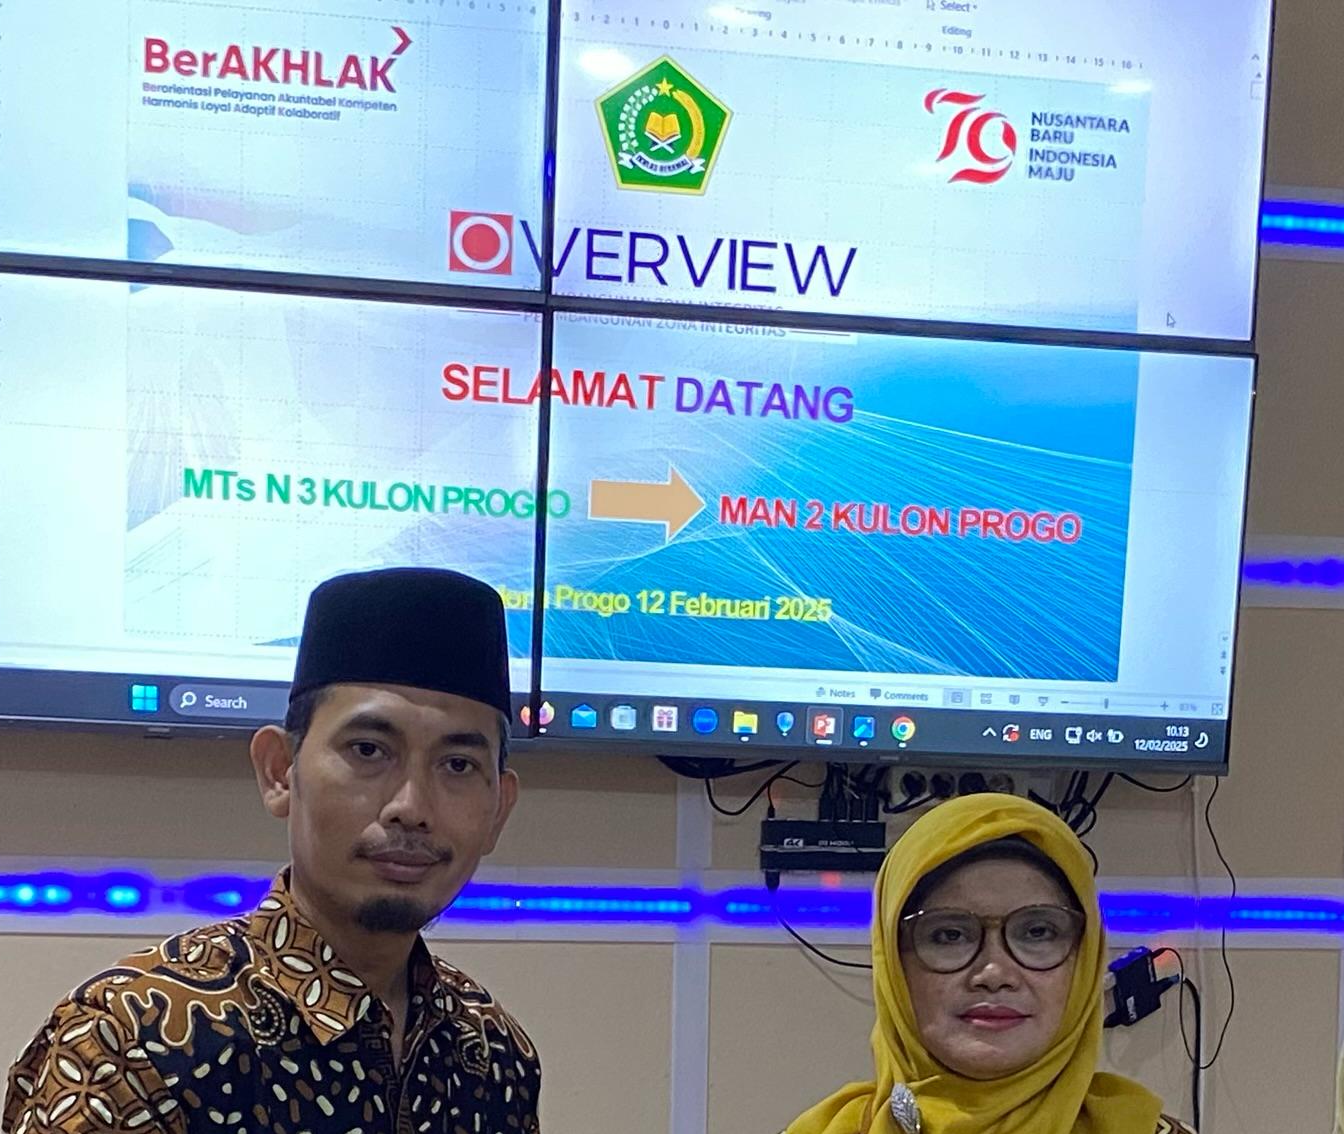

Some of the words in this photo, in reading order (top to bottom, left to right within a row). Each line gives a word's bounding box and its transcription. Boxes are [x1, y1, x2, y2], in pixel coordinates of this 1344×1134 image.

[940, 1, 970, 12] Select
[144, 37, 397, 93] BerAKHLAK
[143, 82, 211, 97] Berorientasi
[214, 87, 276, 103] Pelayanan
[278, 92, 336, 107] Akuntabel
[338, 97, 397, 112] Kompeten
[143, 96, 198, 110] Harmonis
[201, 99, 231, 113] Loyal
[233, 103, 275, 118] Adaptif
[278, 106, 341, 121] Kolaboratif
[1031, 111, 1131, 133] NUSANTARA
[1030, 128, 1074, 144] BARU
[1029, 148, 1117, 169] INDONESIA
[1028, 164, 1075, 182] MAJU
[450, 211, 857, 297] OVERVIEW
[442, 363, 665, 410] SELAMAT
[675, 376, 854, 423] DATANG
[184, 468, 256, 502] MTs
[266, 474, 290, 504] N
[297, 477, 317, 506] 3
[323, 479, 435, 513] KULON
[442, 486, 571, 519] PROGO
[720, 495, 796, 530] MAN
[805, 502, 823, 530] 2
[832, 503, 950, 537] KULON
[958, 508, 1083, 544] PROGO
[555, 585, 631, 616] Progo
[637, 589, 665, 614] 12
[669, 592, 771, 619] Februari
[774, 596, 832, 622] 2025
[205, 694, 247, 709] Search
[829, 686, 856, 698] Notes
[884, 690, 929, 702] Comments
[1029, 728, 1053, 740] ENG
[1166, 725, 1190, 737] 10.13
[1134, 738, 1189, 751] 12/02/2025
